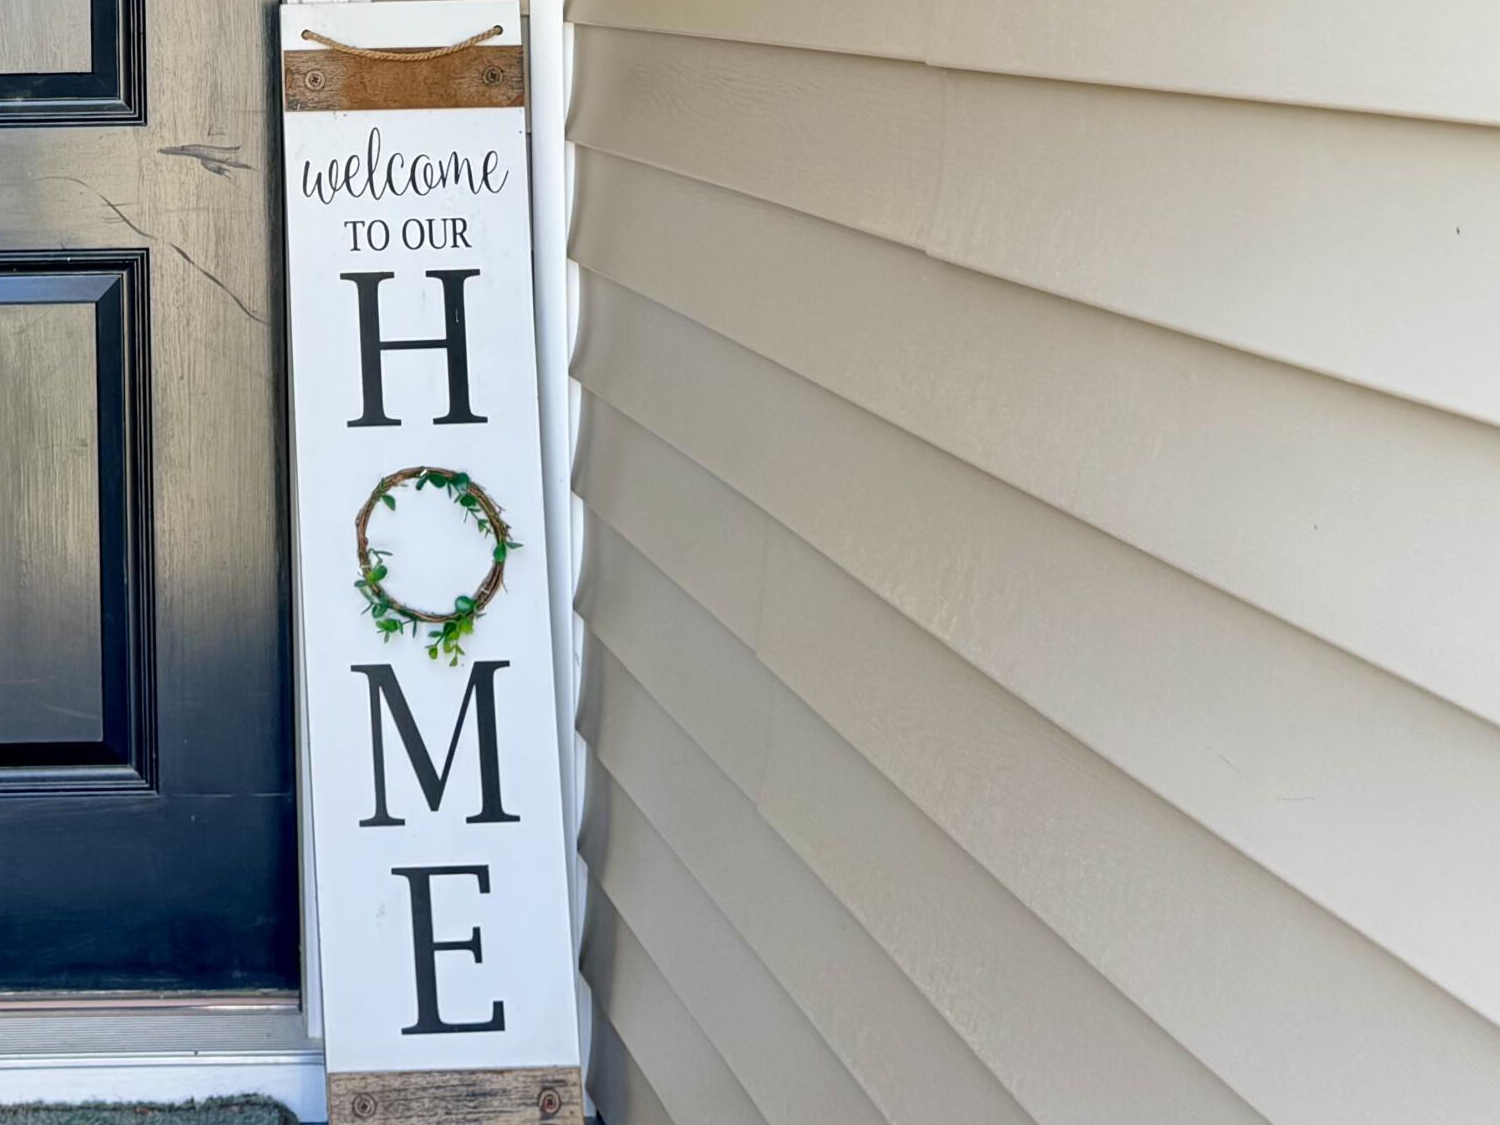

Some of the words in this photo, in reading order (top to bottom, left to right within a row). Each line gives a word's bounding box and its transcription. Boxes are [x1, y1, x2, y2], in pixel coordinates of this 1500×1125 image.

[302, 127, 509, 204] welcome
[344, 219, 390, 251] TO
[402, 218, 472, 250] OUR
